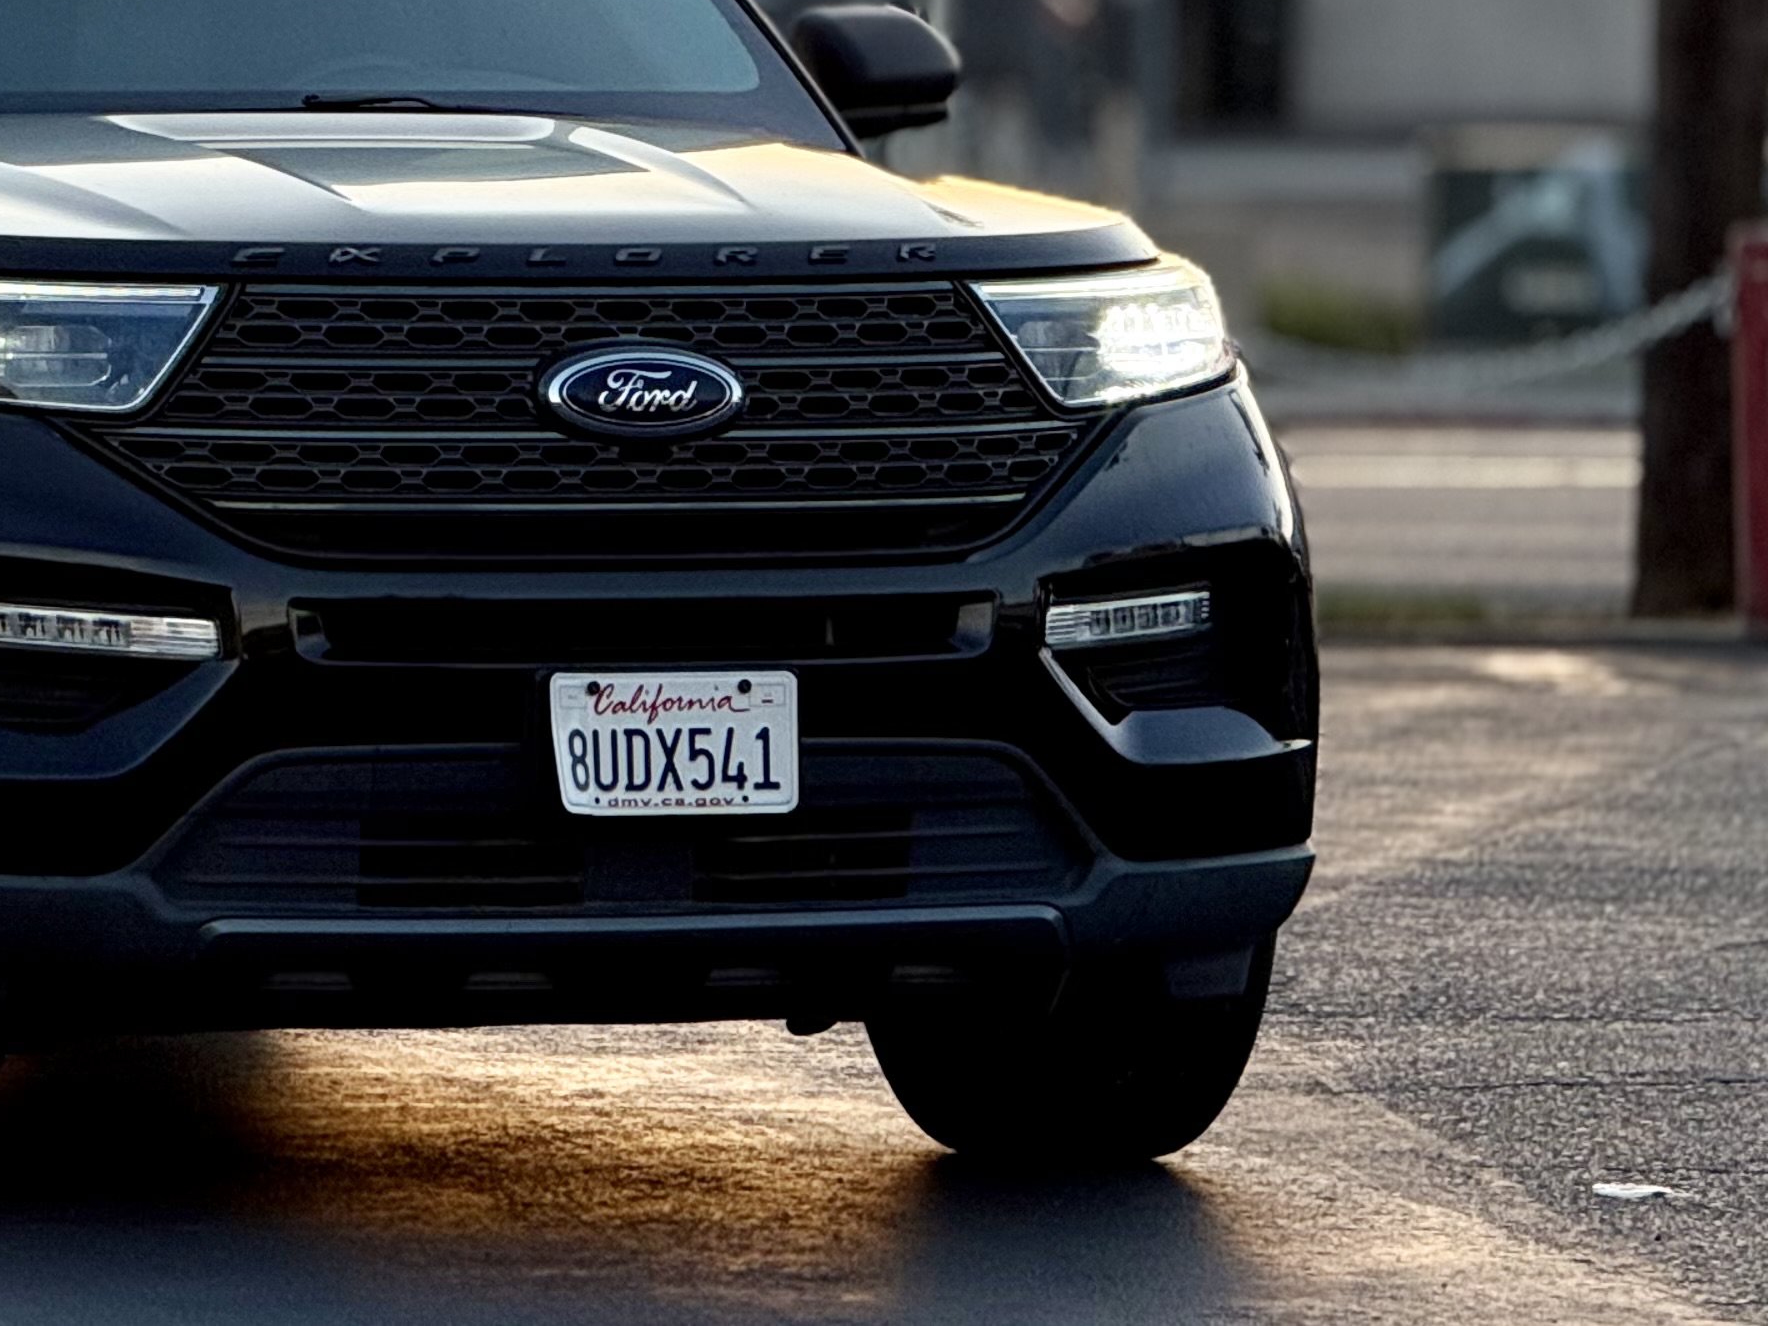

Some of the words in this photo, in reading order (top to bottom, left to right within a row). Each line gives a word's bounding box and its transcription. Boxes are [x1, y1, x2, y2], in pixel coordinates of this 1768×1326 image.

[232, 241, 939, 265] EXPLORER
[598, 368, 698, 413] Ford
[593, 683, 750, 724] California
[568, 727, 781, 792] 8UDX541
[607, 796, 735, 807] dmv.ca.gov
